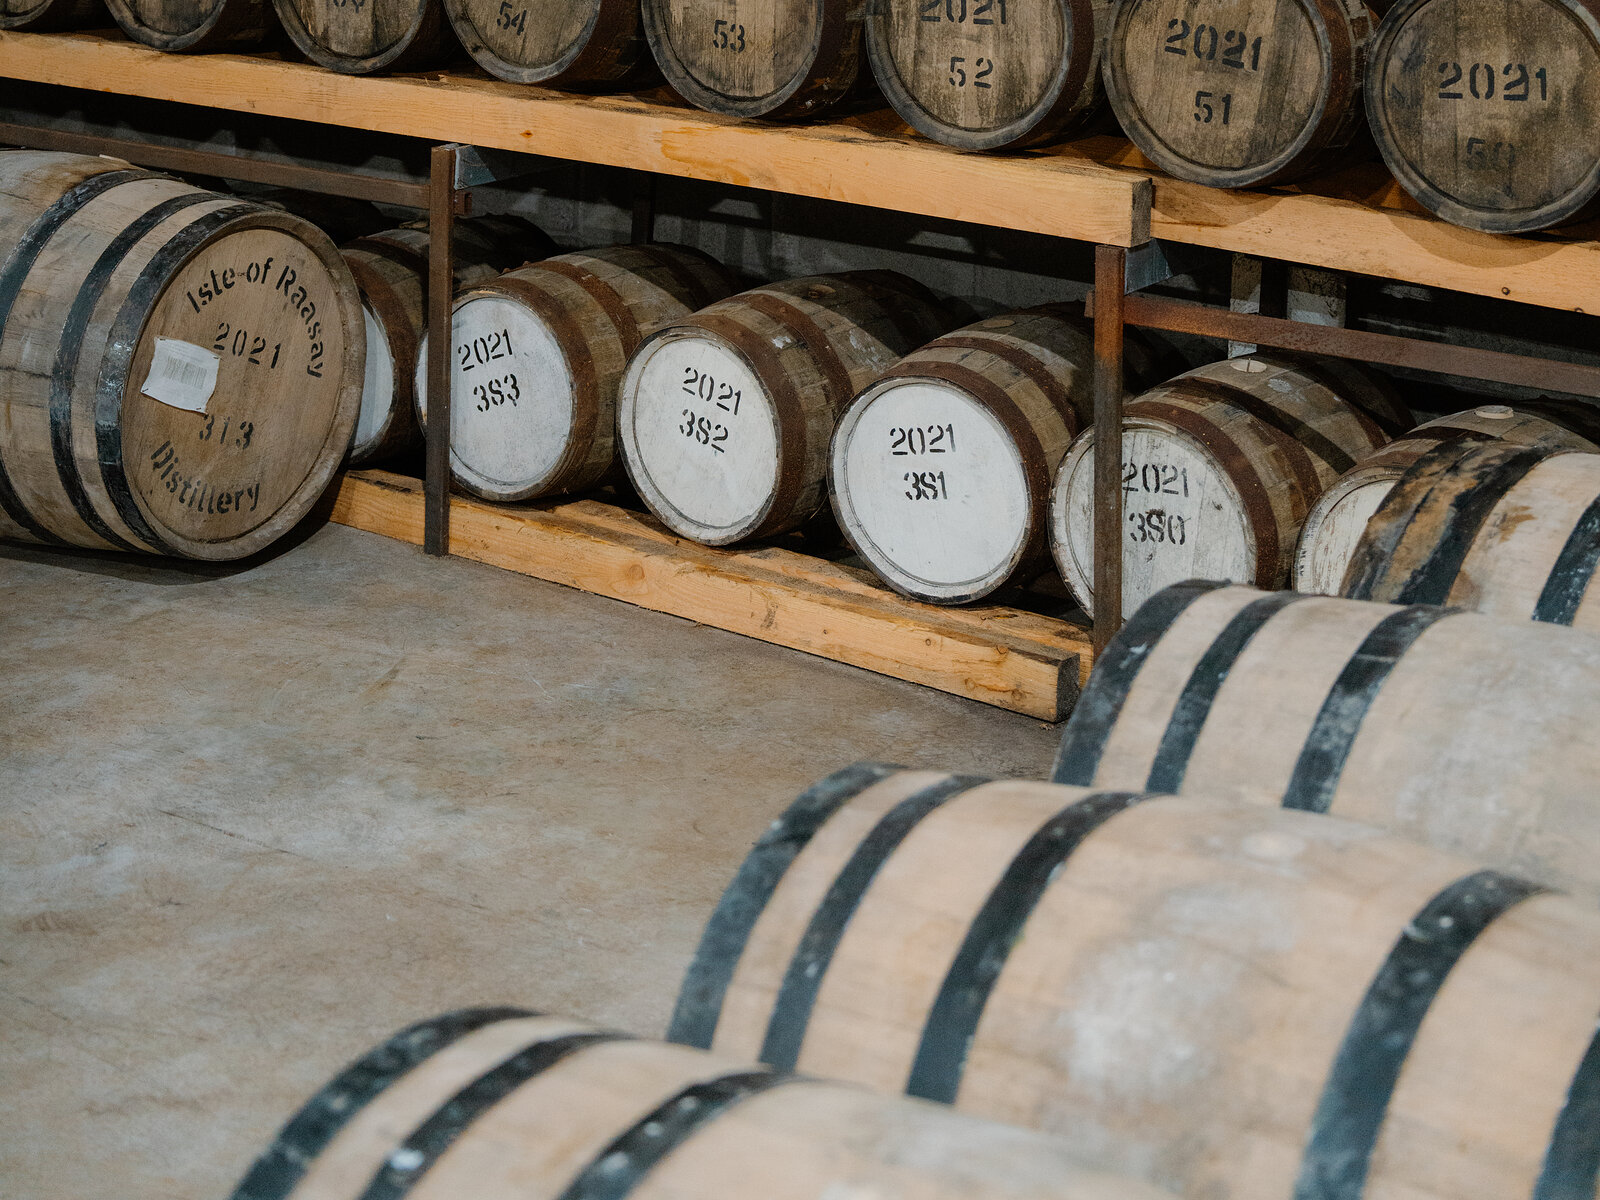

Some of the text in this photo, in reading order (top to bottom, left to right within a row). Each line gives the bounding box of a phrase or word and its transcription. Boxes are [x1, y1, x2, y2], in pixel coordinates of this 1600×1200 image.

[496, 1, 527, 37] 54
[712, 19, 746, 54] 53
[1164, 18, 1262, 72] 2021
[948, 56, 994, 89] 52
[1438, 62, 1547, 101] 2021
[1193, 90, 1232, 125] 51
[276, 265, 324, 379] Raasay
[212, 322, 282, 369] 2021
[457, 328, 513, 372] 2021
[682, 367, 741, 415] 2021
[199, 413, 254, 451] 313
[889, 423, 957, 456] 2021
[151, 440, 261, 515] Distillery
[1121, 462, 1189, 498] 2021
